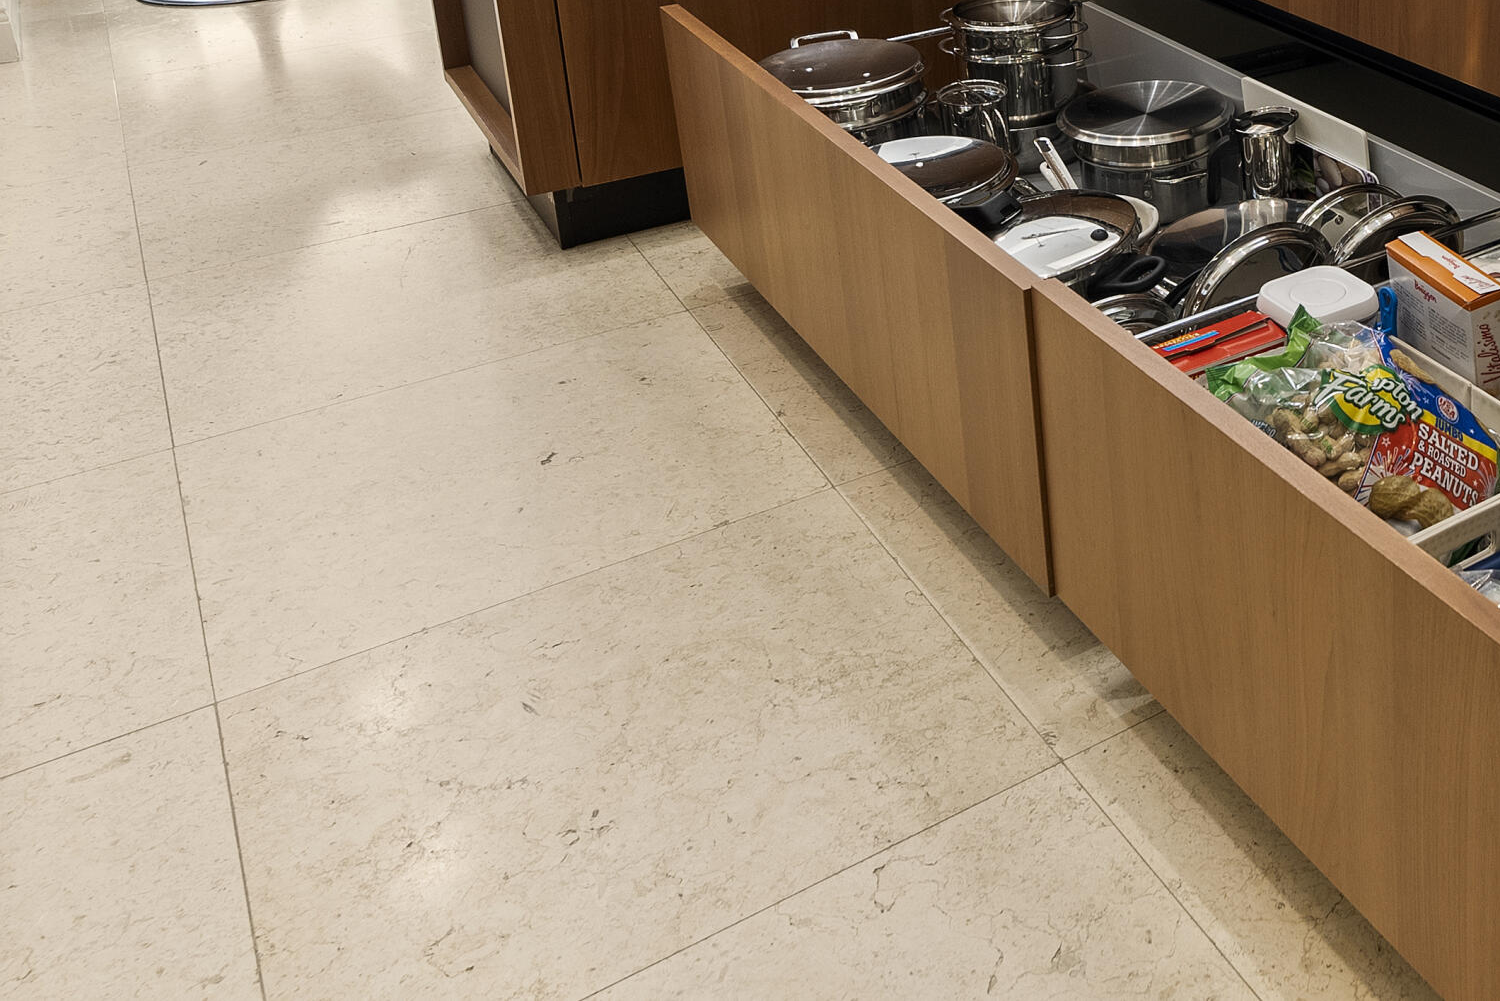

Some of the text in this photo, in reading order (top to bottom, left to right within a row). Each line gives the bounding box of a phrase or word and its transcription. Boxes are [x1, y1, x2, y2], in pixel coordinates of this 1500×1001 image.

[1314, 370, 1405, 430] Farms
[1418, 422, 1479, 472] SALTED
[1418, 439, 1467, 477] & ROASTED
[1410, 452, 1479, 507] PEANUTS
